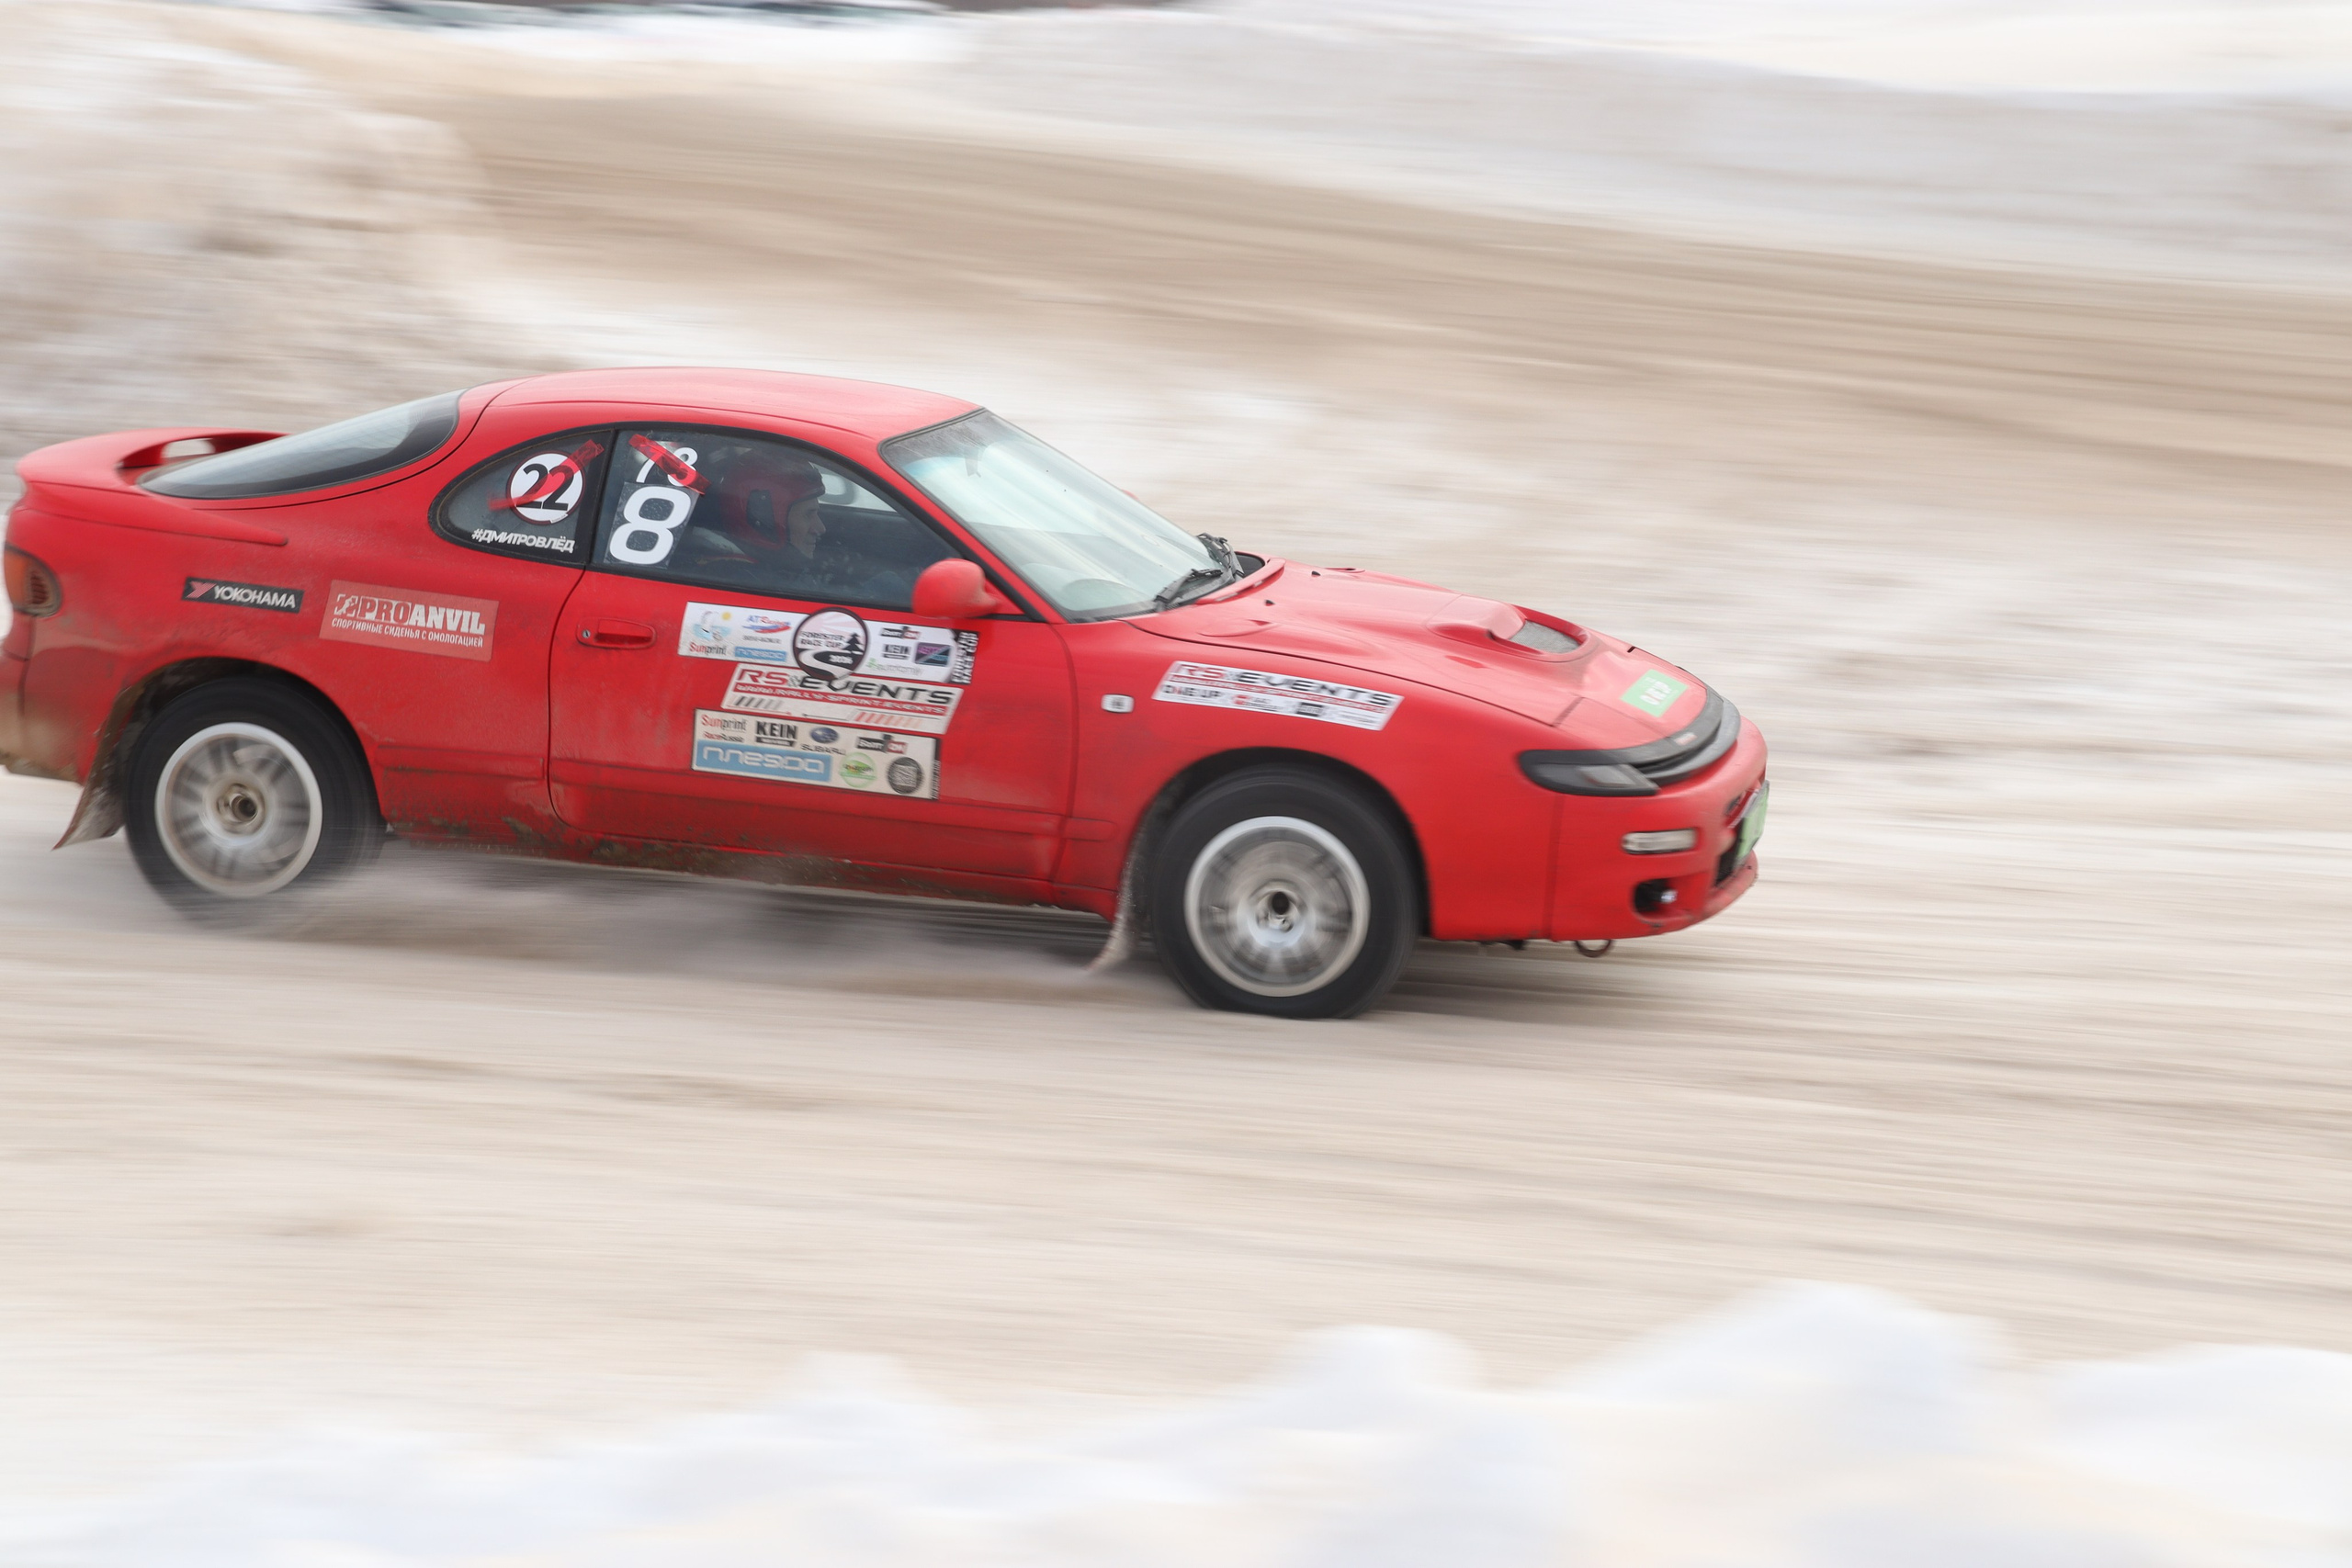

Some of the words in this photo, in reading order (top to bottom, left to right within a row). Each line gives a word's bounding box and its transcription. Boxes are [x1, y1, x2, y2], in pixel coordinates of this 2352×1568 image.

[515, 463, 575, 512] 22
[471, 527, 575, 553] #ДМИТРОВЛЁД
[610, 486, 691, 565] 8
[214, 585, 296, 608] YOKOHAMA
[357, 595, 486, 635] PROANVIL
[332, 617, 382, 634] СПОРТИВНЫЕ
[384, 625, 420, 639] СИДЕНЬЯ
[421, 631, 426, 639] С
[428, 631, 483, 648] ОМОЛОГАЦИЕЙ
[738, 668, 789, 686] RS
[798, 676, 954, 705] EVENTS
[701, 714, 746, 731] Sunprint
[755, 720, 797, 740] KEIN
